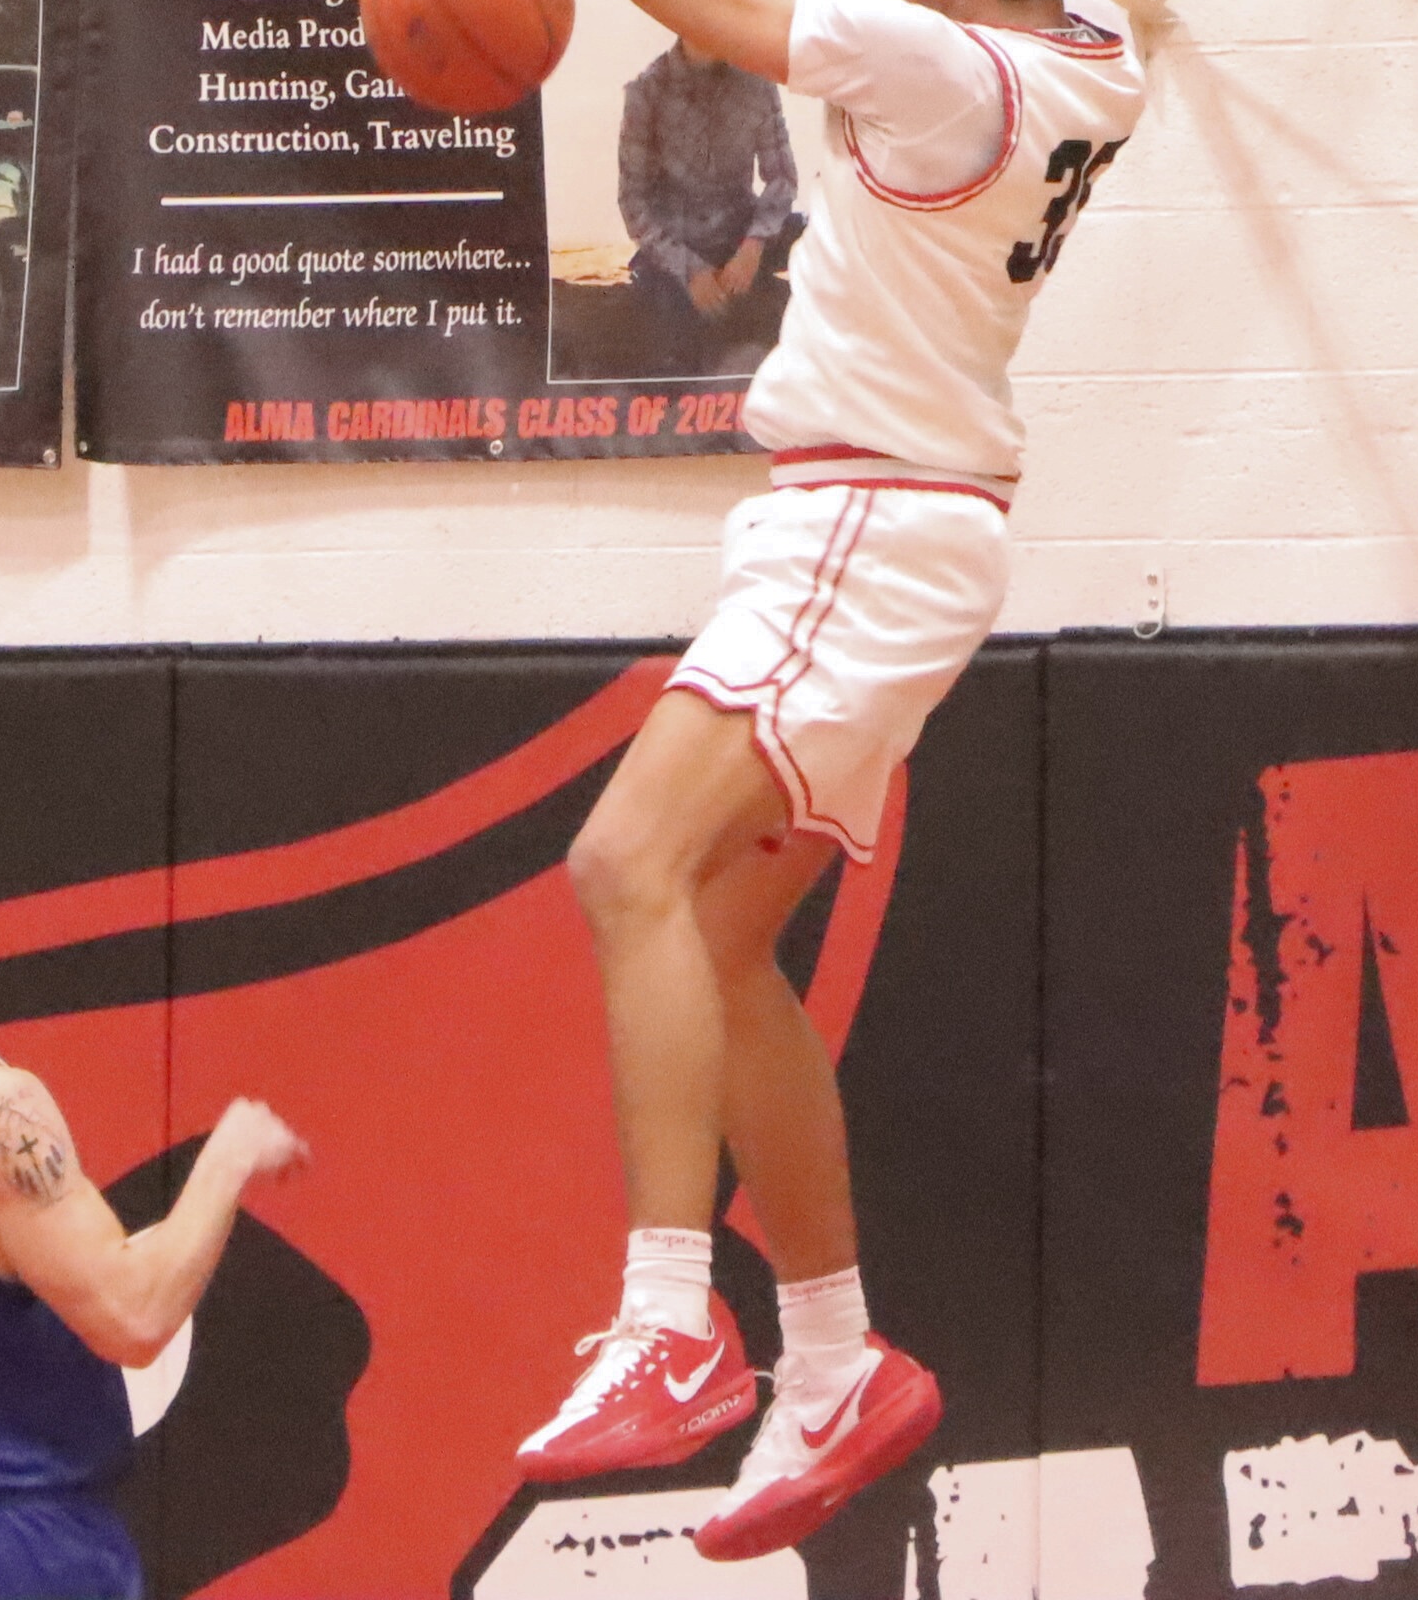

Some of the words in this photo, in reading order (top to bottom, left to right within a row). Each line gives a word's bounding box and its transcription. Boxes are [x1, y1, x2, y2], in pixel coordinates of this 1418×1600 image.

[201, 18, 290, 50] Media
[298, 16, 366, 48] Prod
[199, 72, 335, 110] Hunting,
[346, 70, 404, 98] Ga
[149, 123, 359, 154] Construction,
[368, 116, 516, 158] Traveling
[133, 248, 143, 273] I
[155, 244, 203, 274] had
[209, 254, 224, 273] a
[230, 242, 292, 285] good
[298, 250, 364, 284] quote
[373, 239, 530, 272] somewhere...
[140, 299, 205, 329] don't
[214, 297, 335, 329] remember
[343, 296, 417, 327] where
[427, 300, 437, 325] I
[444, 303, 487, 337] put
[497, 299, 521, 325] it.
[226, 403, 313, 440] ALMA
[328, 399, 502, 439] CARDINALS
[519, 398, 616, 436] CLASS
[628, 396, 668, 434] OF
